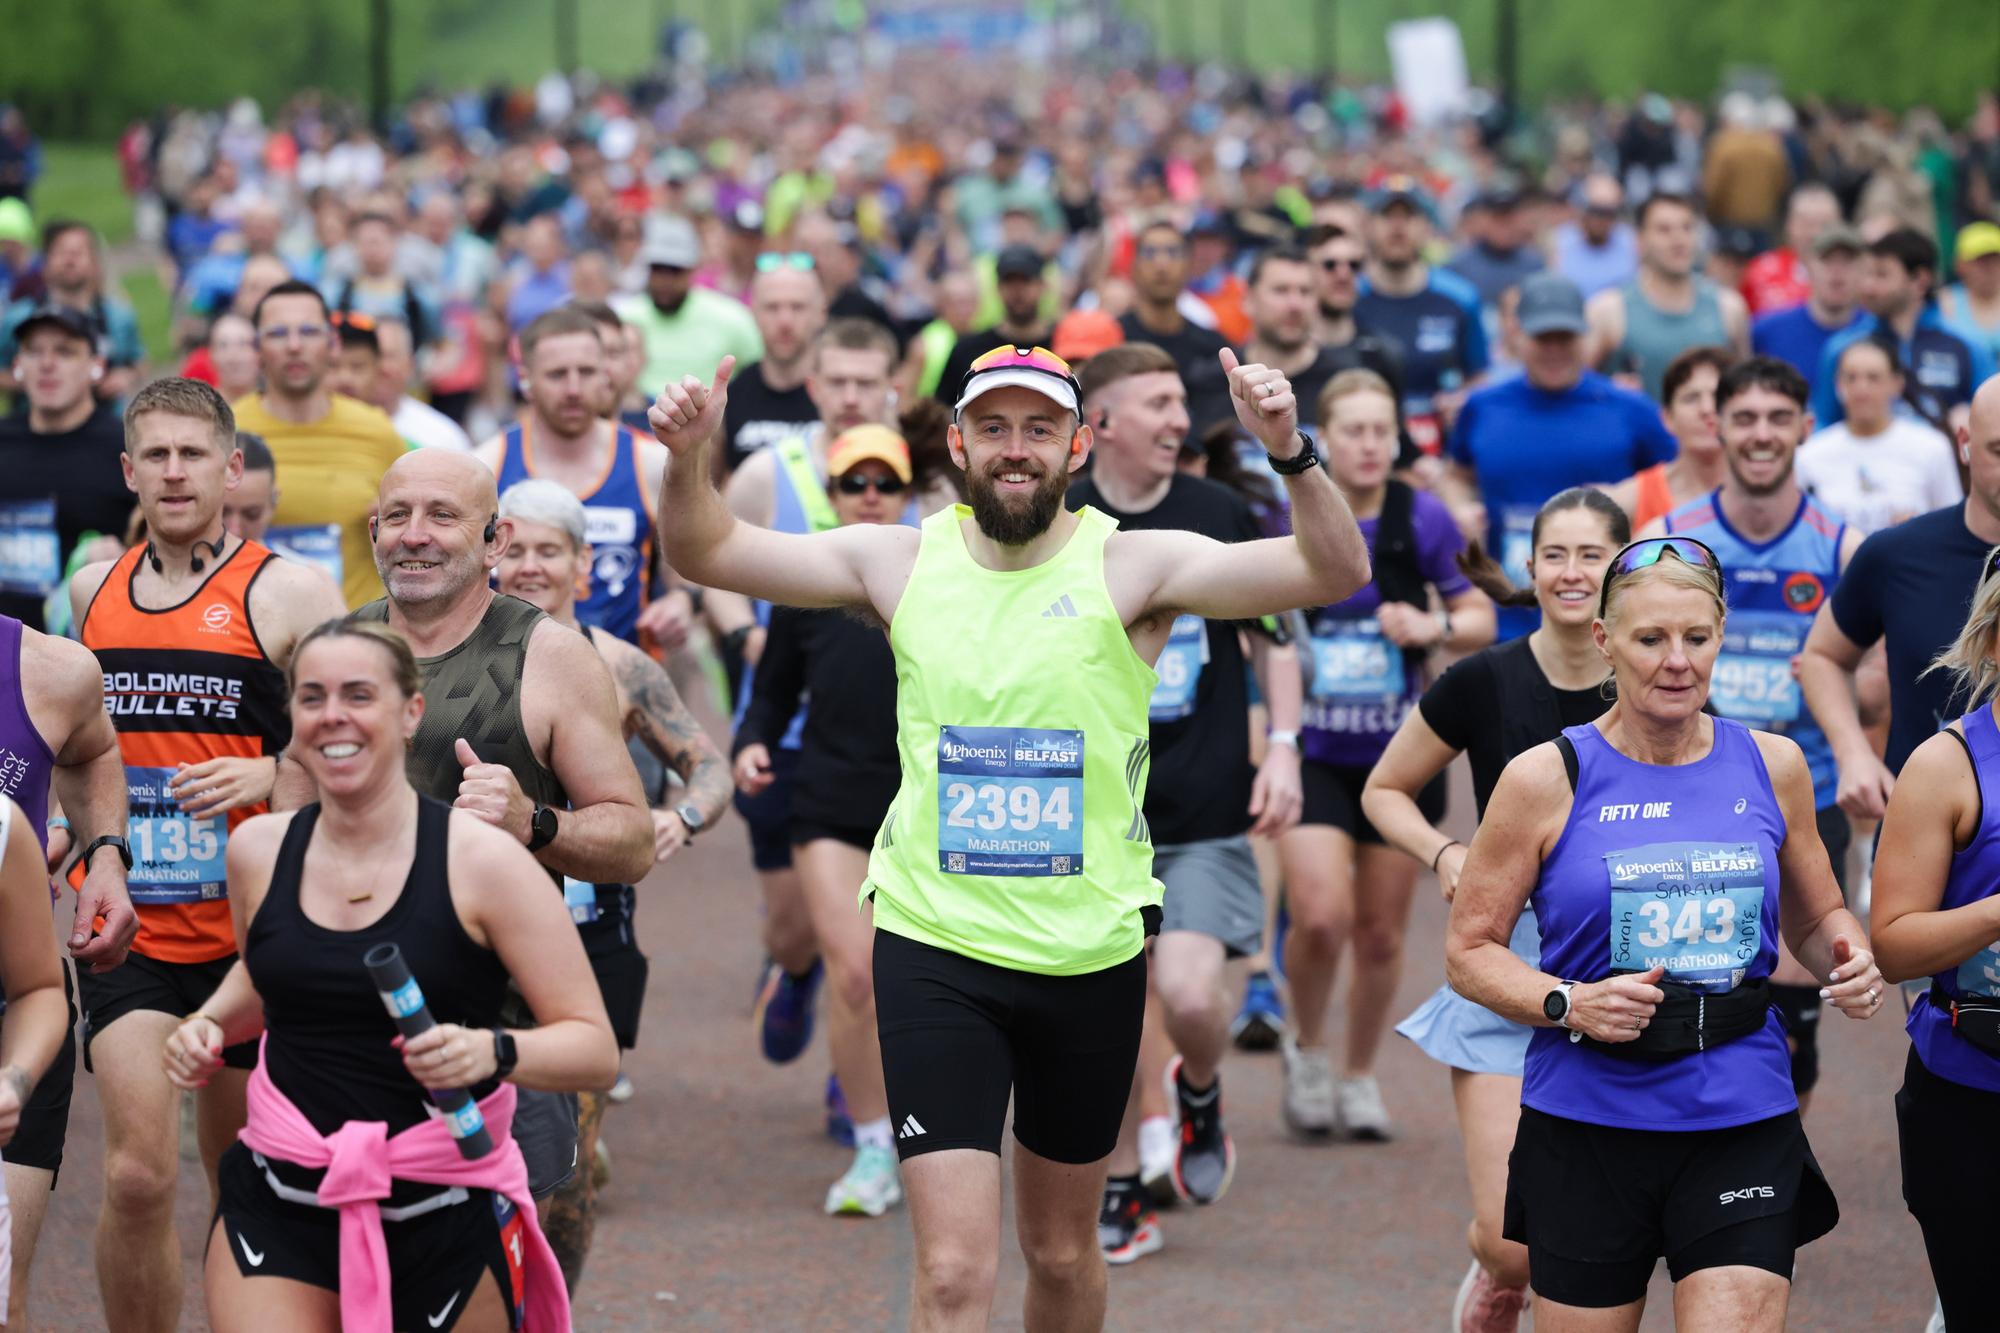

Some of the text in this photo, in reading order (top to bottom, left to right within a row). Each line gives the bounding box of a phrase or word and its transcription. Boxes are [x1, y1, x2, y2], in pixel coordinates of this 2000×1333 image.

[103, 672, 243, 699] BOLDMERE
[1710, 660, 1792, 702] 952
[104, 695, 239, 720] BULLETS
[953, 744, 1006, 759] Phoenix
[1014, 750, 1078, 763] BELFAST
[0, 751, 19, 786] ncy
[985, 759, 1006, 767] Energy
[0, 758, 30, 796] Trust
[946, 782, 1073, 831] 2394
[1599, 802, 1672, 822] FIFTY ONE
[126, 819, 218, 862] 135
[968, 838, 1050, 851] MARATHON
[129, 870, 199, 880] MARATHON
[1626, 859, 1684, 874] Phoenix
[1692, 859, 1756, 873] BELFAST
[1655, 882, 1726, 899] SARAH
[1638, 898, 1736, 948] 343
[1615, 911, 1633, 963] Sarah
[1645, 953, 1728, 969] MARATHON
